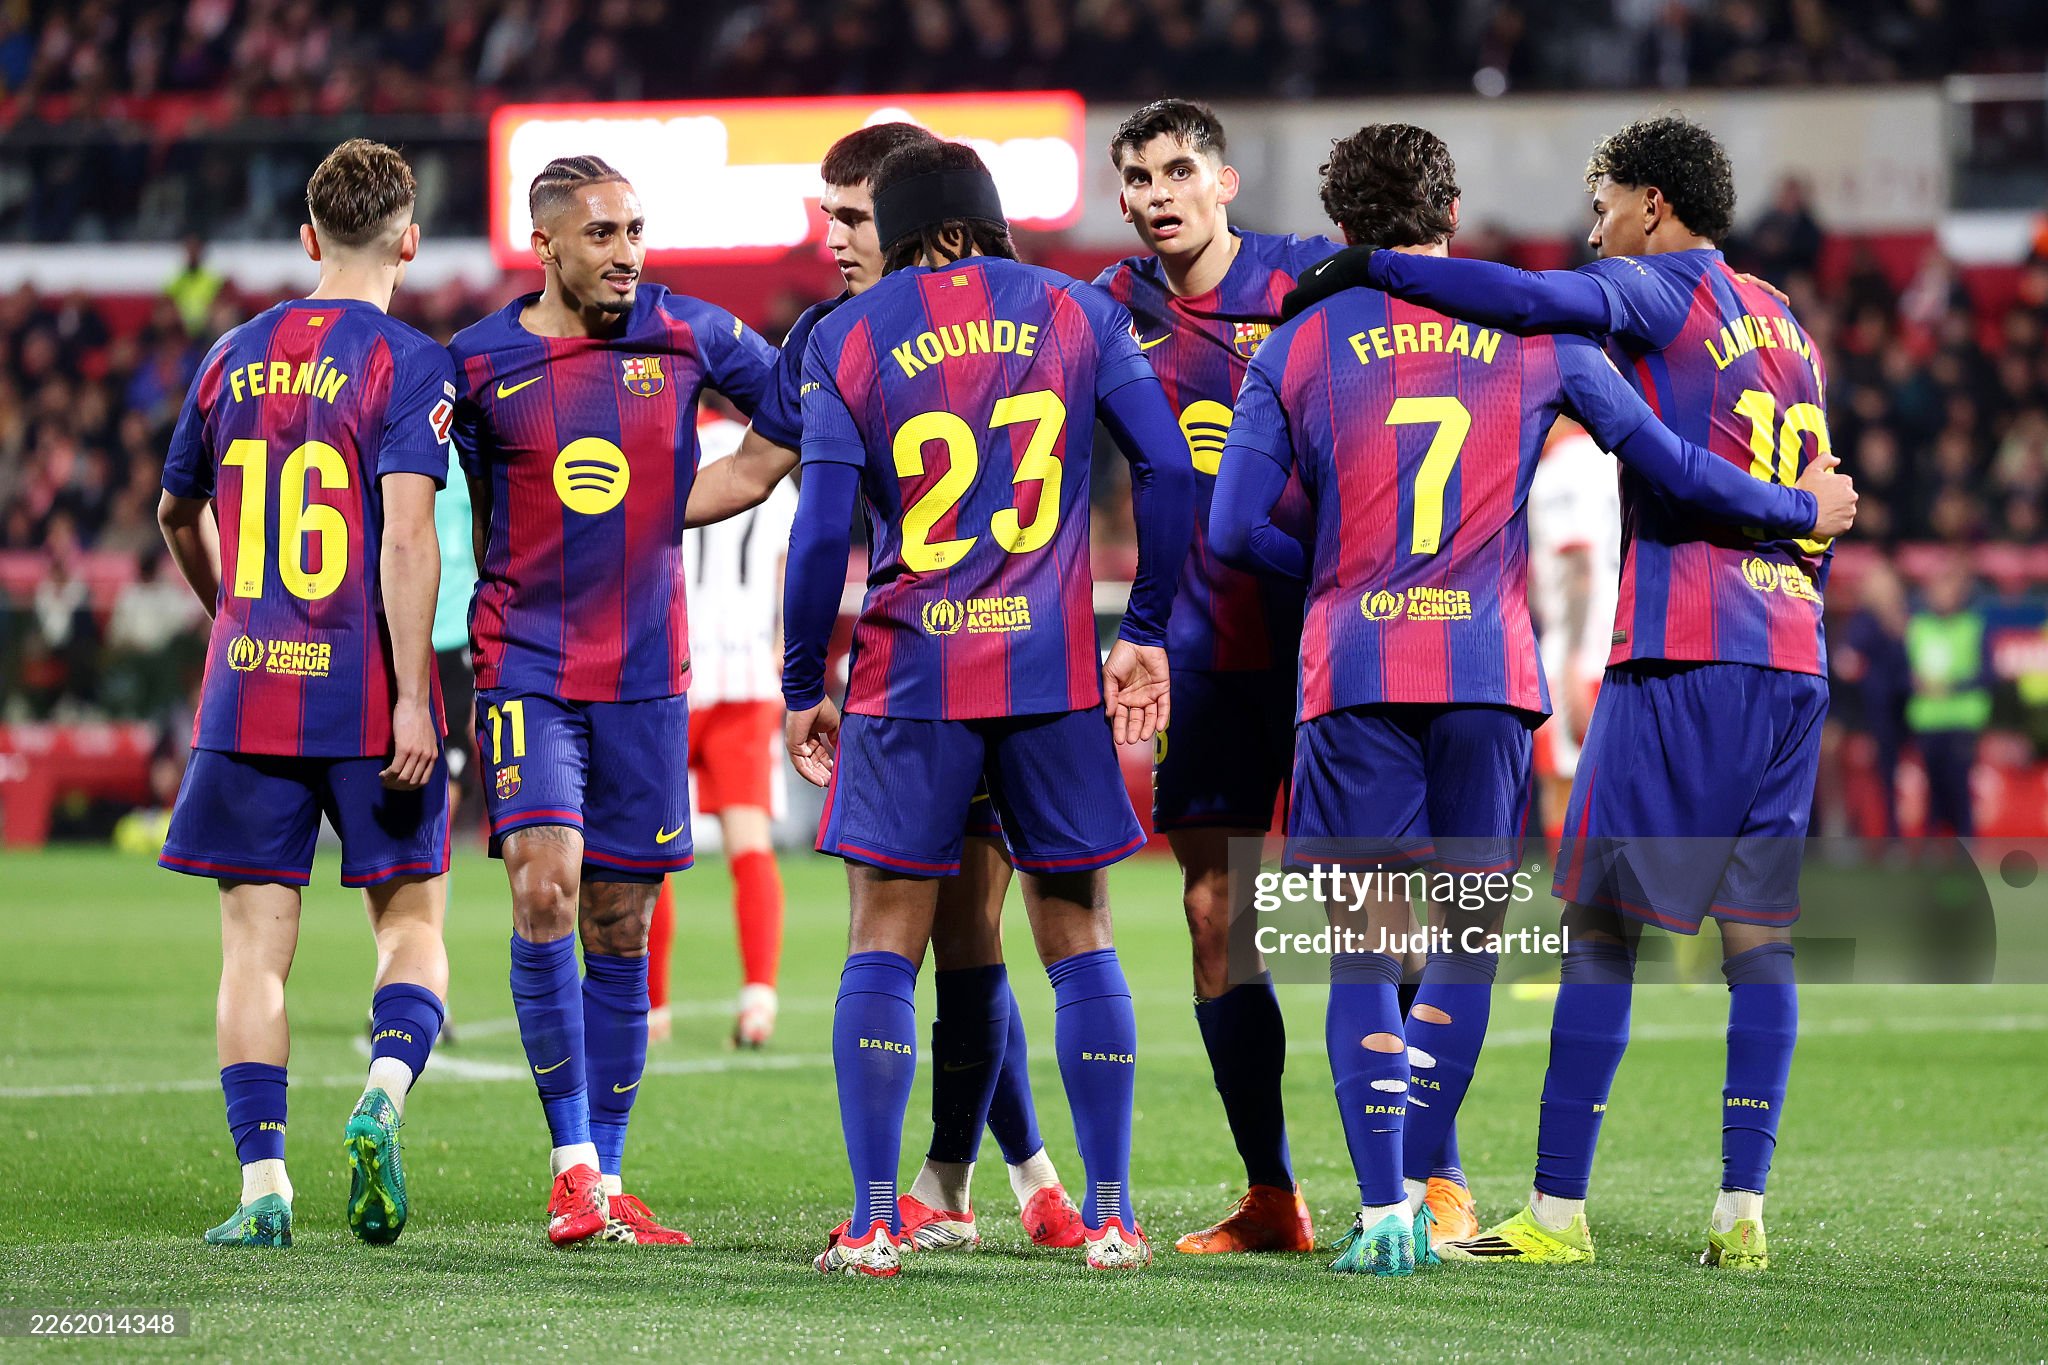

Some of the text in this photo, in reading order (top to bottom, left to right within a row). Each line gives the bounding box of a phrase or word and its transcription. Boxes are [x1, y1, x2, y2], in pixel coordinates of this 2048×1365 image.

[891, 320, 1039, 379] KOUNDE
[1348, 322, 1502, 365] FERRAN
[230, 356, 348, 404] FERMÍN
[893, 389, 1067, 572] 23
[1384, 396, 1472, 555] 7
[1733, 389, 1835, 554] 10
[221, 439, 349, 600] 16
[967, 596, 1029, 613] UNHCR
[1407, 587, 1471, 603] UNHCR
[1407, 601, 1472, 615] ACNUR
[967, 610, 1031, 627] ACNUR
[265, 653, 330, 671] ACNUR
[268, 640, 331, 657] UNHCR
[488, 700, 525, 765] 11
[1410, 1075, 1440, 1091] RÇA
[260, 1121, 286, 1136] BAR
